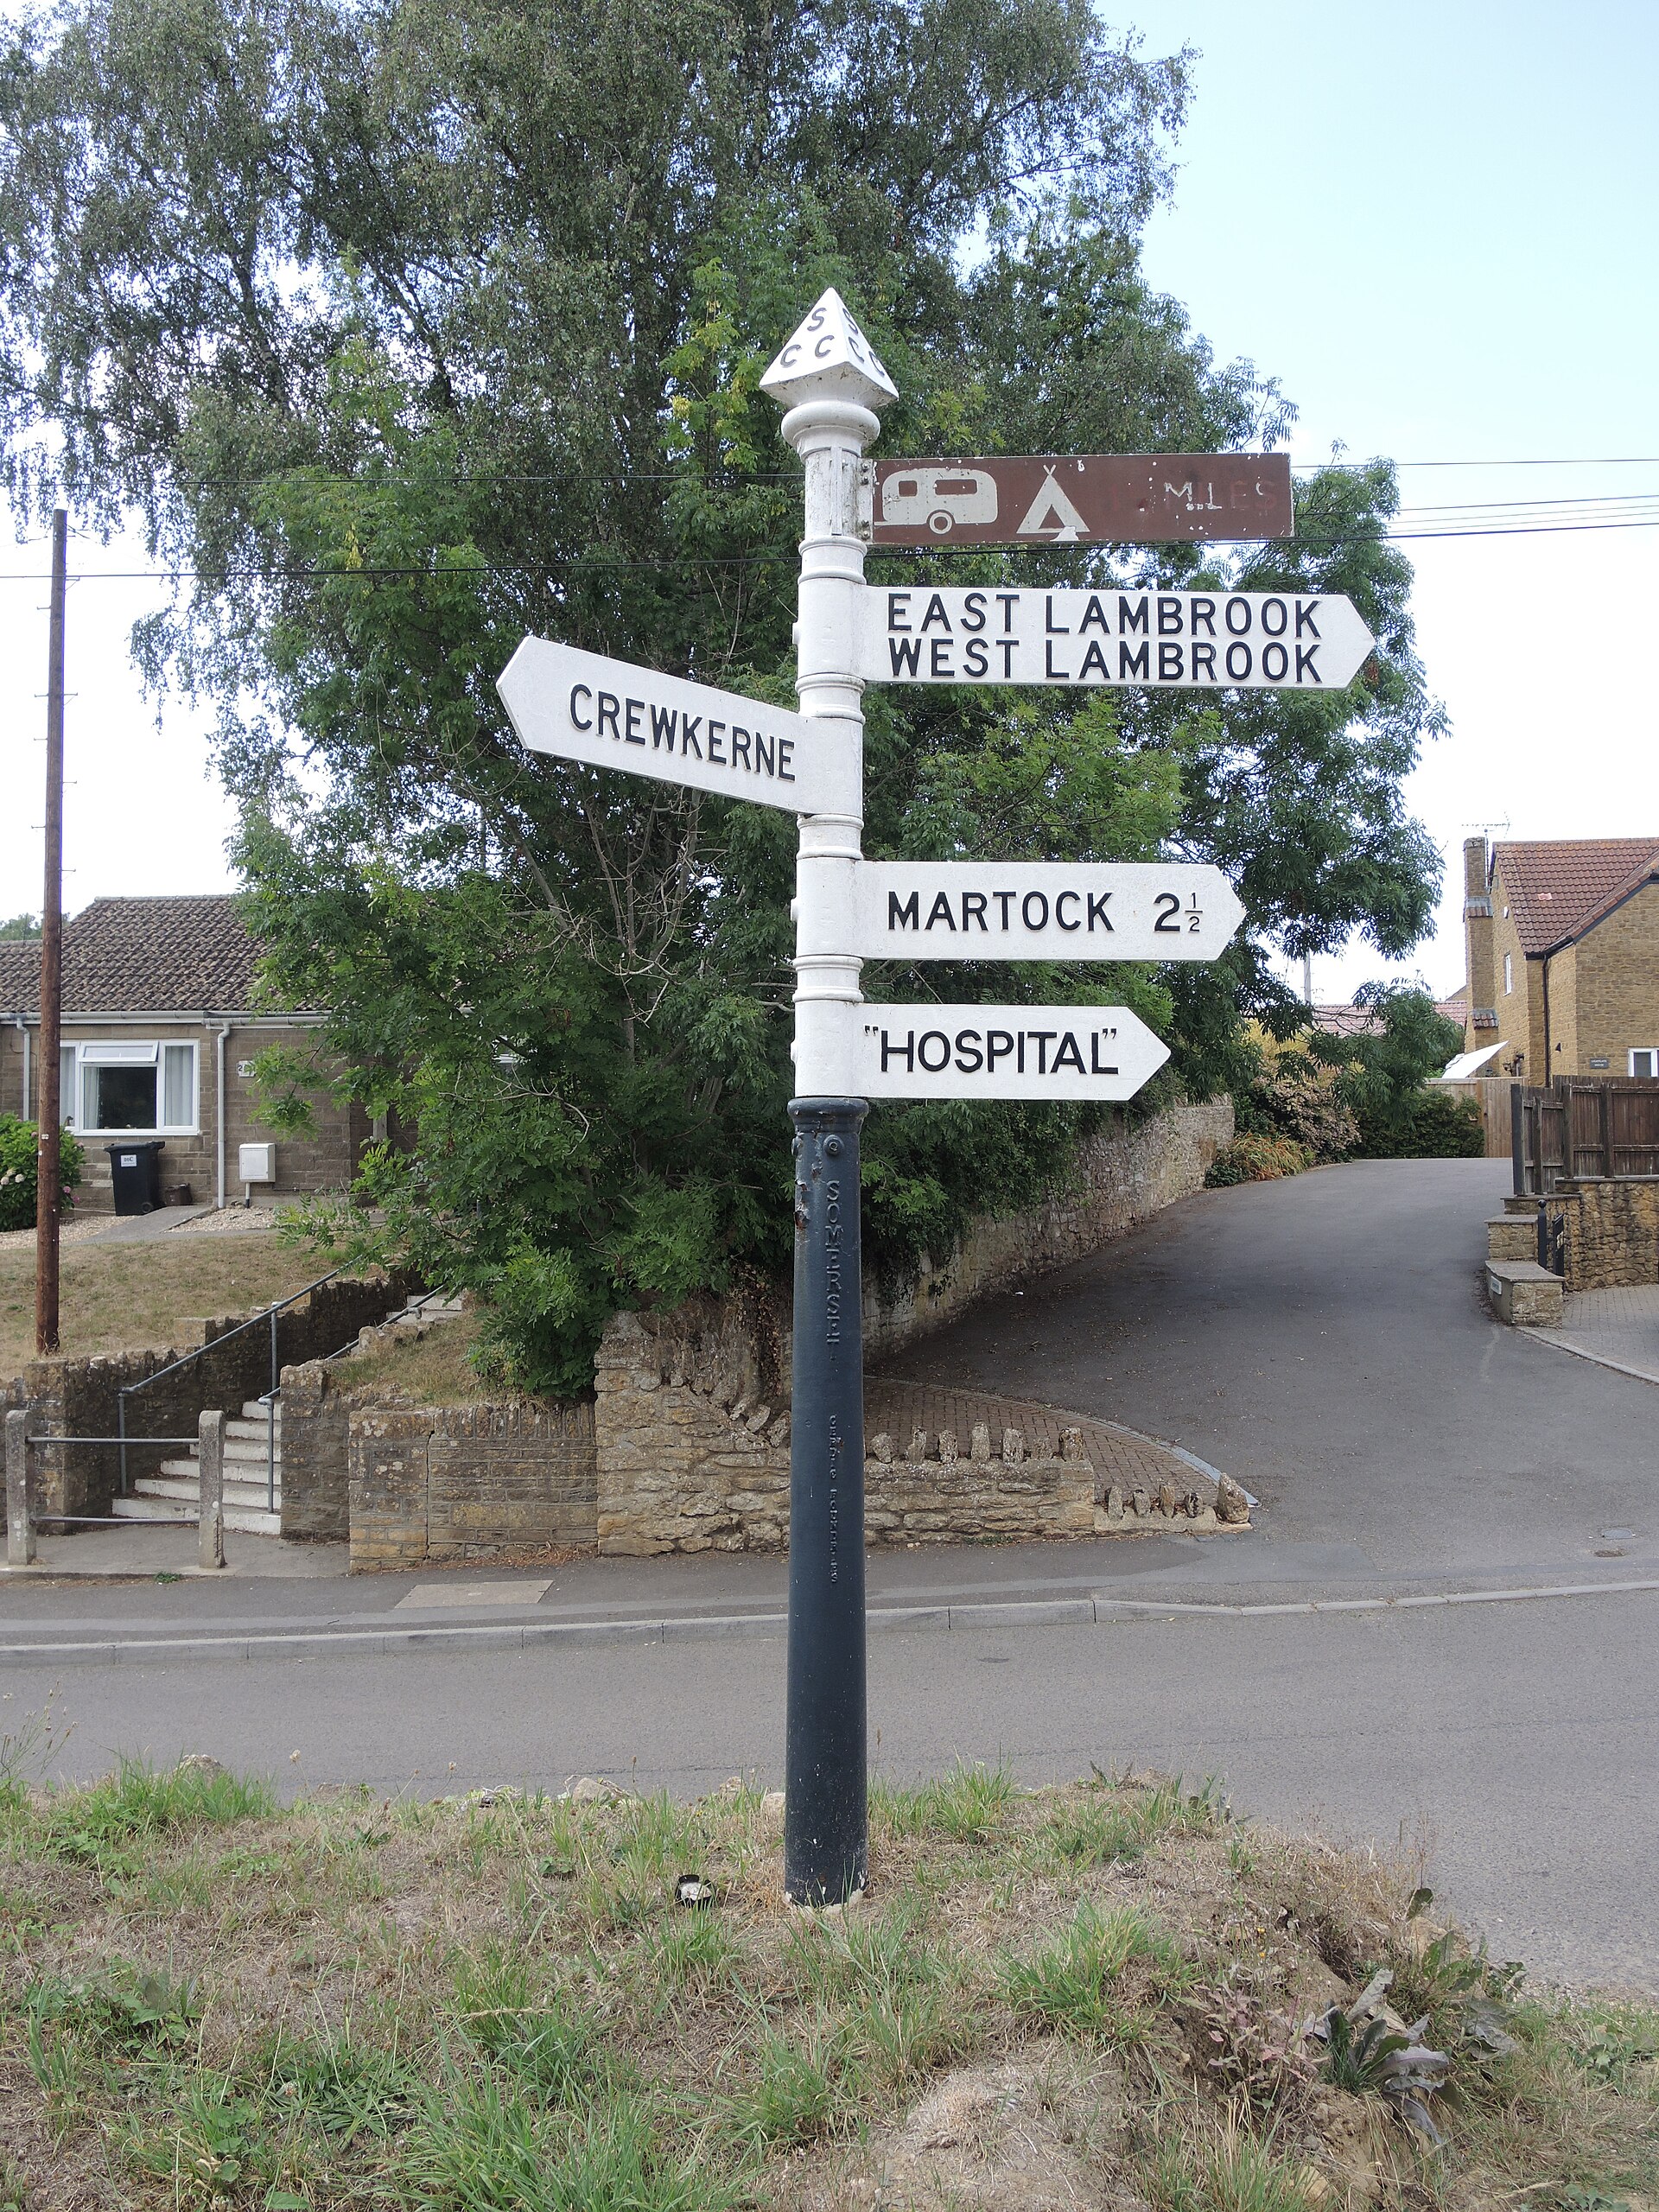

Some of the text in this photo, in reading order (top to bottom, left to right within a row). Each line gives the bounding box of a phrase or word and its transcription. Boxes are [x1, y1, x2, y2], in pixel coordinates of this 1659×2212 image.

[807, 307, 827, 332] S
[887, 592, 1322, 639] EAST LAMBROOK
[888, 638, 1322, 683] WEST LAMBROOK
[569, 683, 796, 782] CREWKERNE
[888, 891, 1115, 932] MARTOCK
[824, 1179, 844, 1360] SOMERSET
